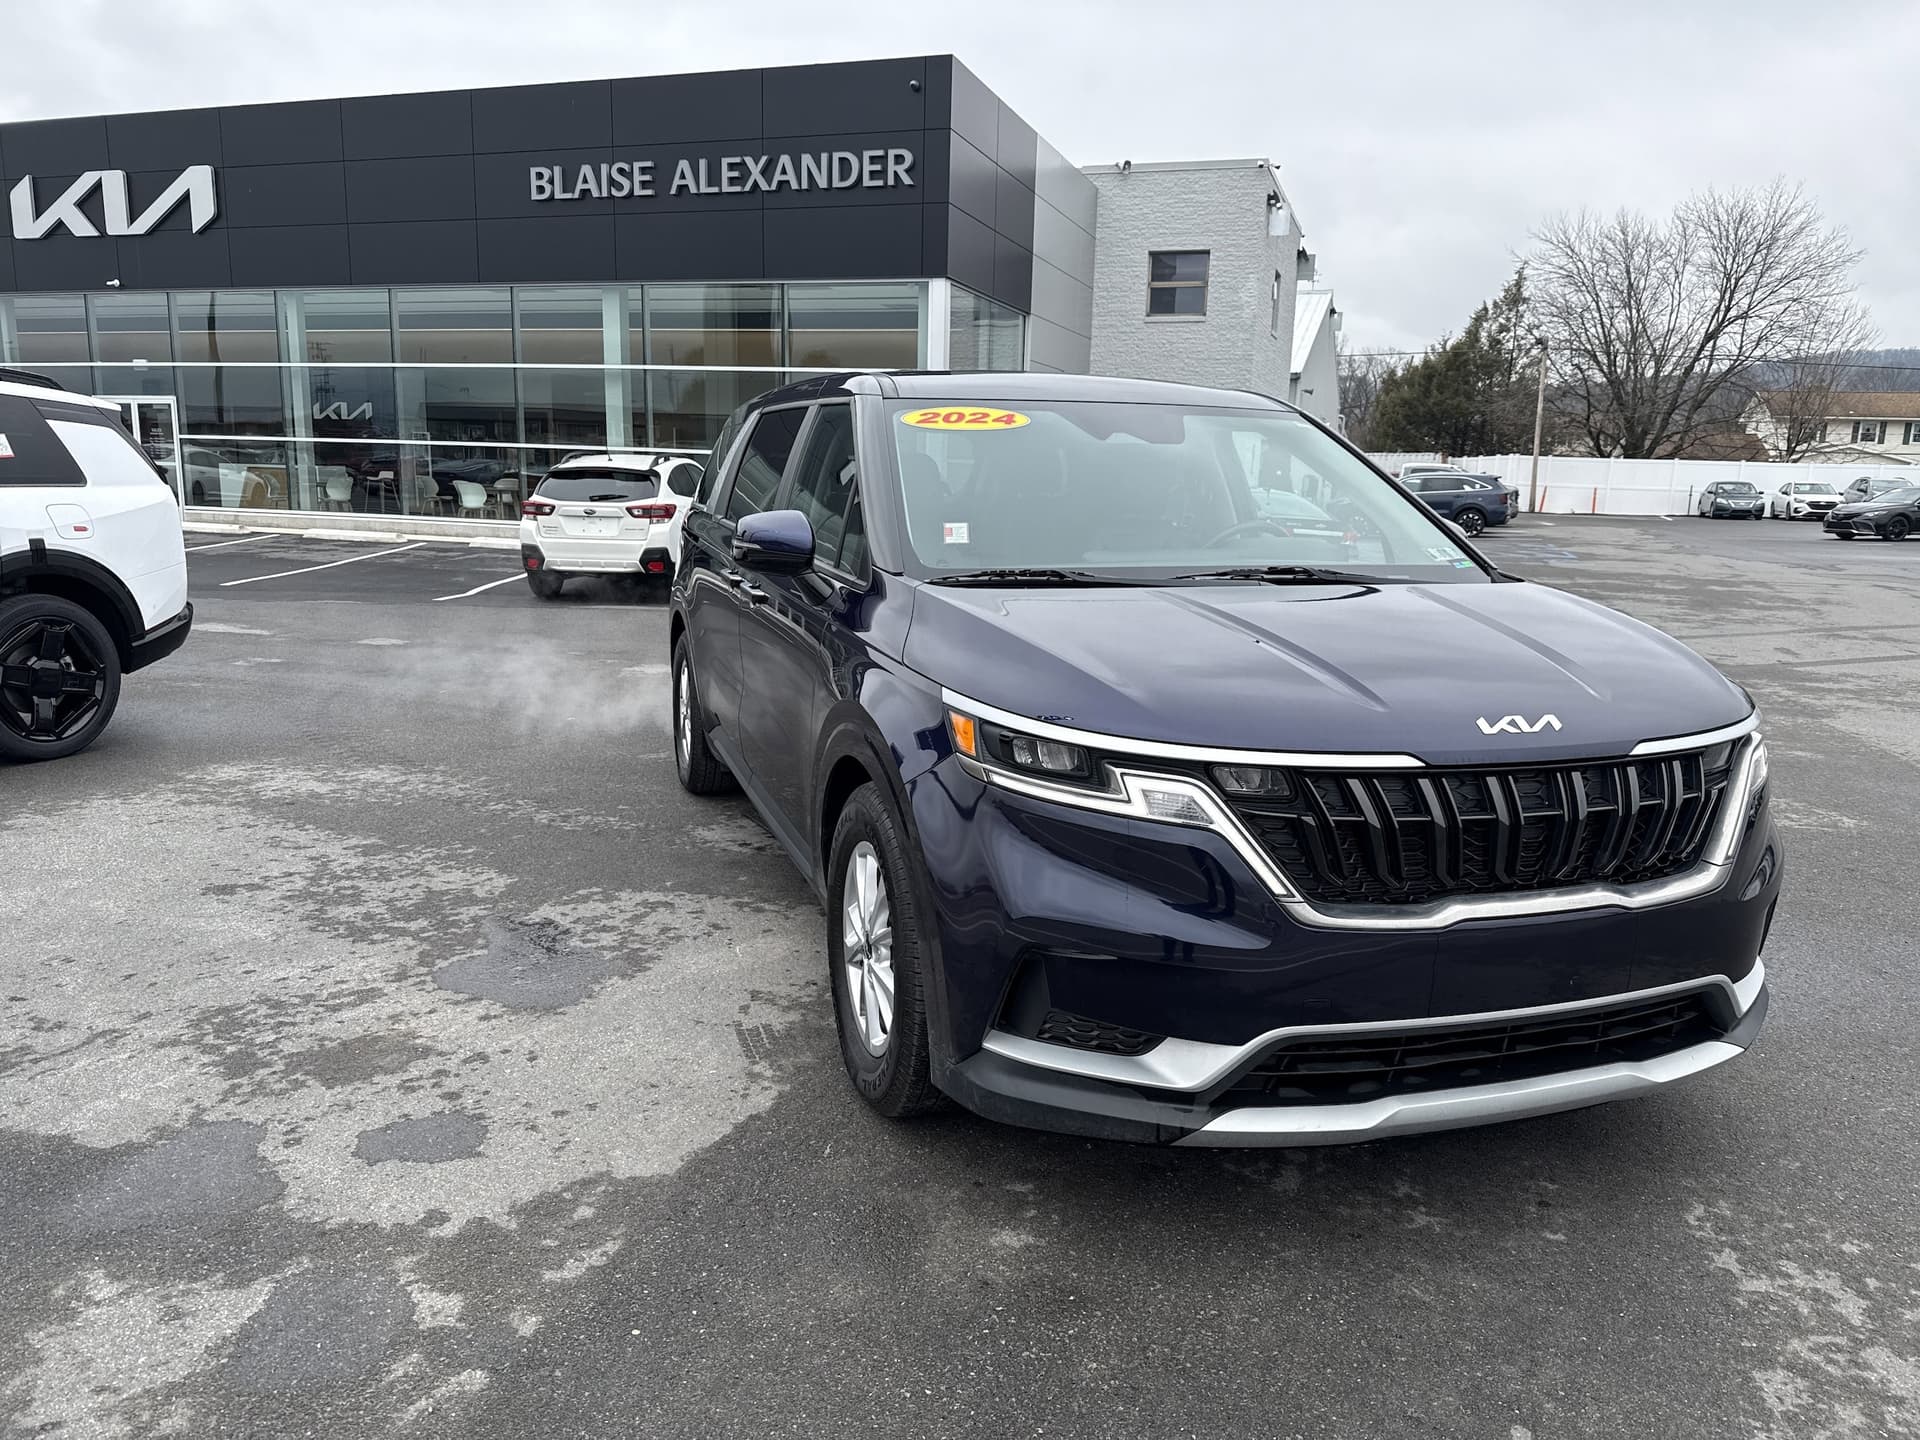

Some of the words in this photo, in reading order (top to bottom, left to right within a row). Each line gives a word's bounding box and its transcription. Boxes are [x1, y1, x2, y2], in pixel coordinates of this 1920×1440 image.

[529, 161, 655, 201] BLAISE
[669, 148, 915, 195] ALEXANDER
[10, 165, 218, 239] KIA
[313, 401, 373, 420] KIA
[915, 412, 1017, 425] 2024
[1475, 713, 1563, 735] KIA
